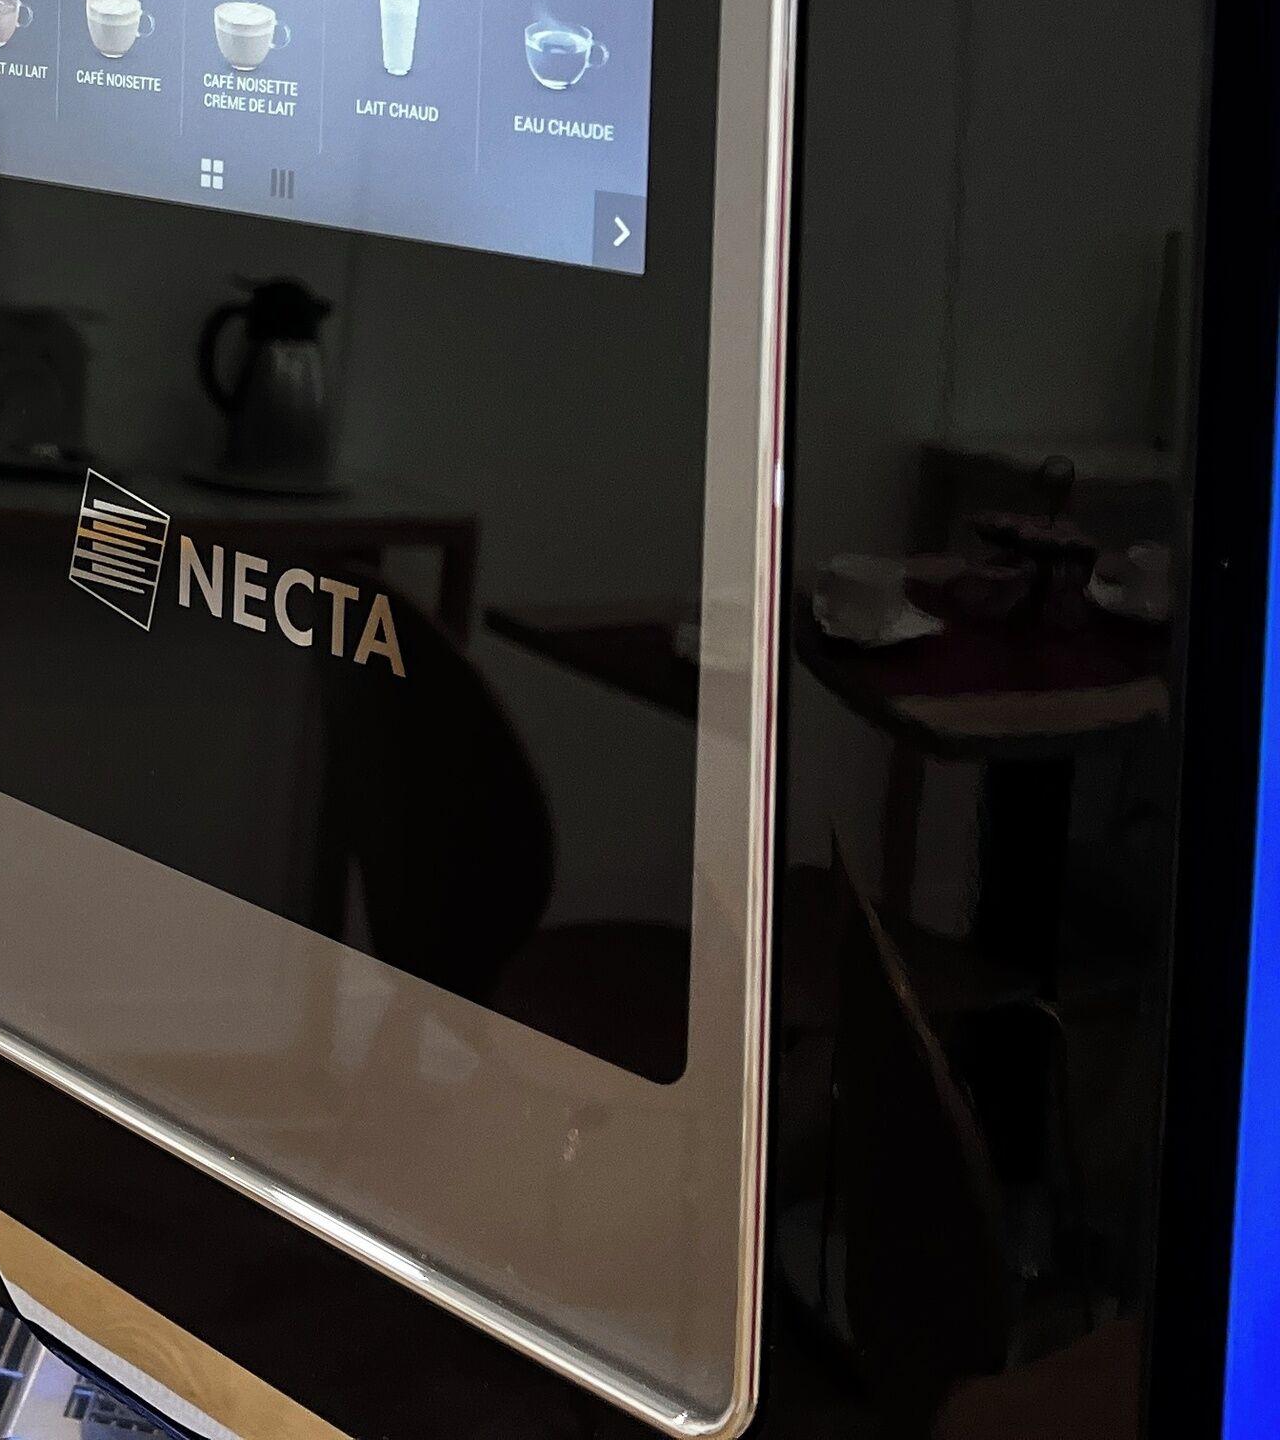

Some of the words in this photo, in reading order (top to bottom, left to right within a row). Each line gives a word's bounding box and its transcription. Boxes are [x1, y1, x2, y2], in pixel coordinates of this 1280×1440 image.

[8, 62, 23, 77] AU
[25, 64, 48, 79] LAIT
[76, 69, 104, 86] CAFÉ
[106, 73, 162, 92] NOISETTE
[203, 72, 234, 90] CAFÉ
[236, 76, 298, 97] NOISETTE
[203, 92, 246, 111] CRÈME
[248, 97, 266, 113] DE
[268, 100, 296, 117] LAIT
[355, 99, 387, 116] LAIT
[389, 102, 439, 122] CHAUD
[514, 115, 545, 134] EAU
[548, 118, 614, 141] CHAUDE
[178, 534, 407, 679] NECTA
